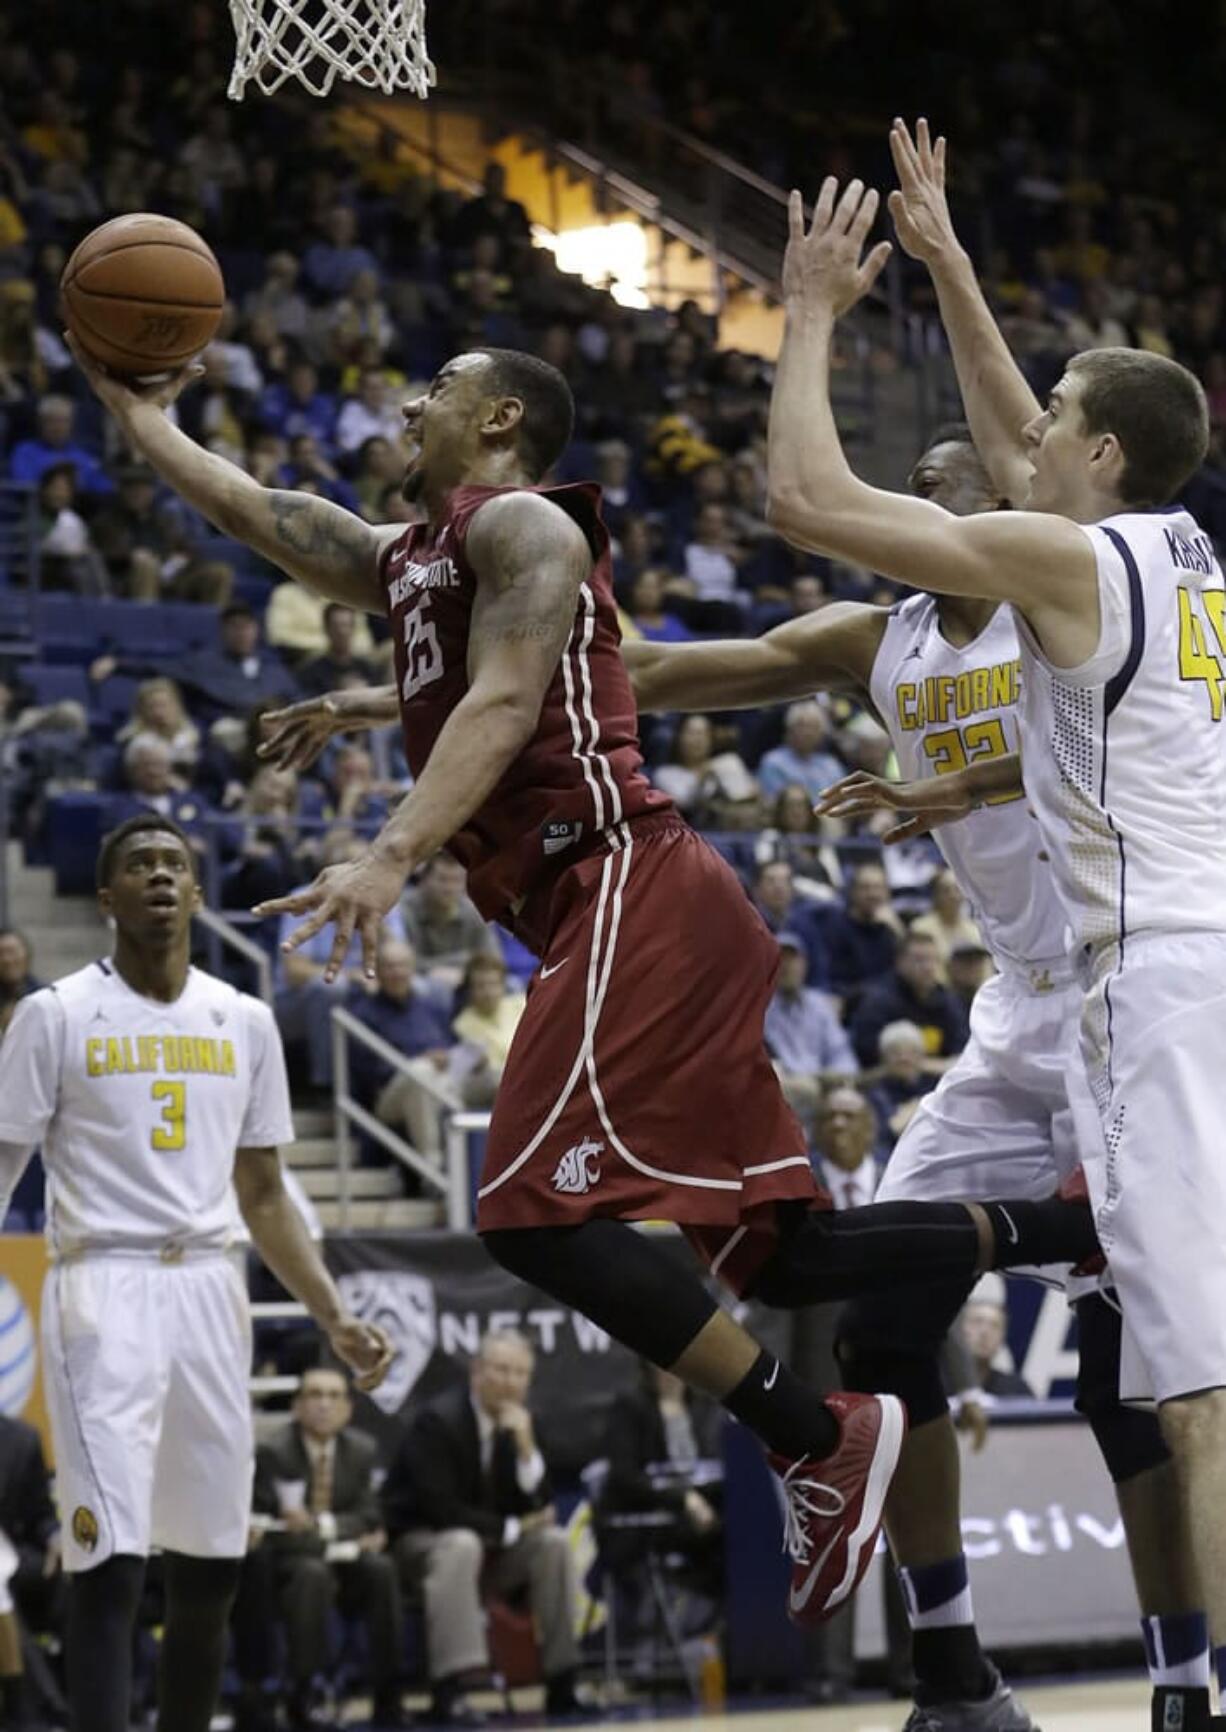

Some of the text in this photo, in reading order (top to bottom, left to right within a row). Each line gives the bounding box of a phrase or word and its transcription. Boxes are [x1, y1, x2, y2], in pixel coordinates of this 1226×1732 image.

[403, 590, 445, 701] 25
[86, 1034, 237, 1078] CALIFORNIA
[151, 1080, 187, 1151] 3
